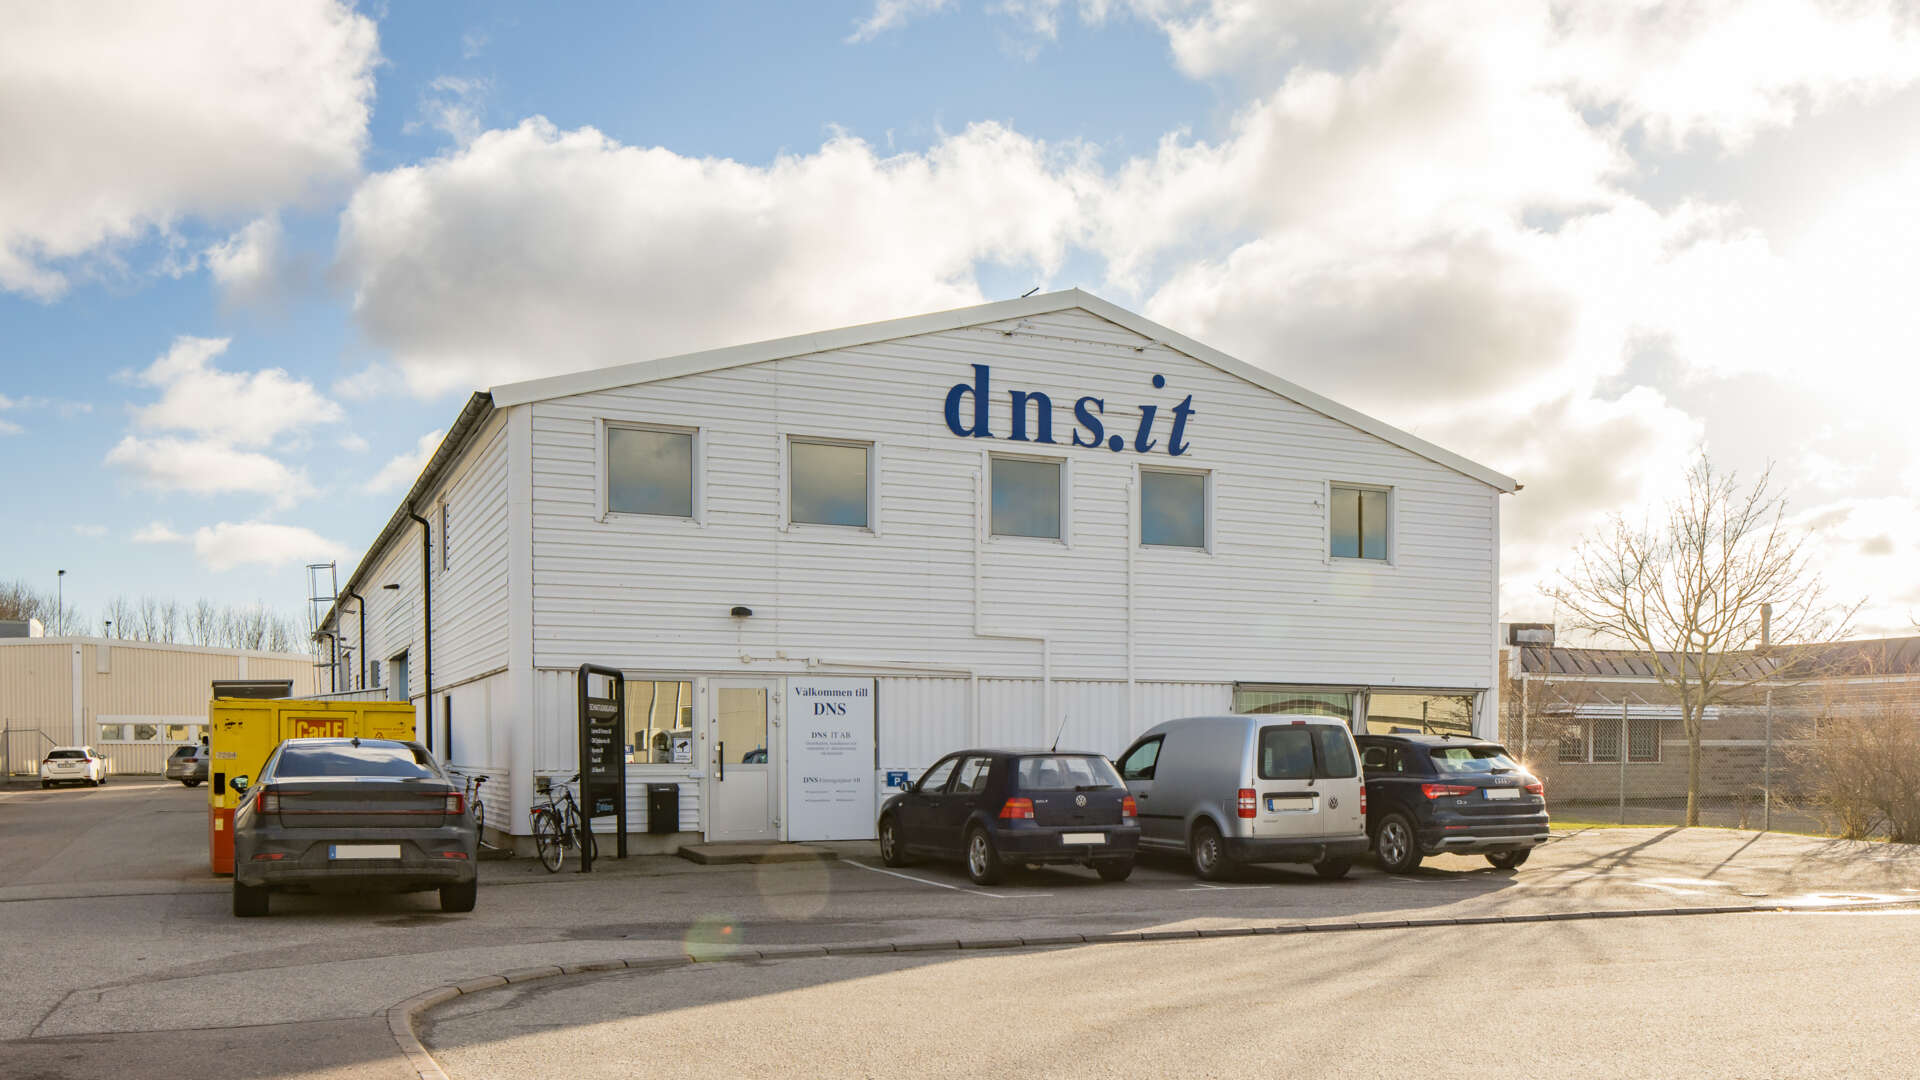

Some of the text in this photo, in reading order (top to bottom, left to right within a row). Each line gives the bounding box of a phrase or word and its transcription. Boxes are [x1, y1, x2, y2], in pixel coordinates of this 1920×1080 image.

[944, 363, 1196, 457] dns.it
[795, 687, 868, 697] Välkommen till
[813, 702, 847, 716] DNS
[811, 731, 828, 739] DNS
[831, 731, 839, 739] IT
[803, 776, 819, 784] DNS
[894, 777, 900, 785] P
